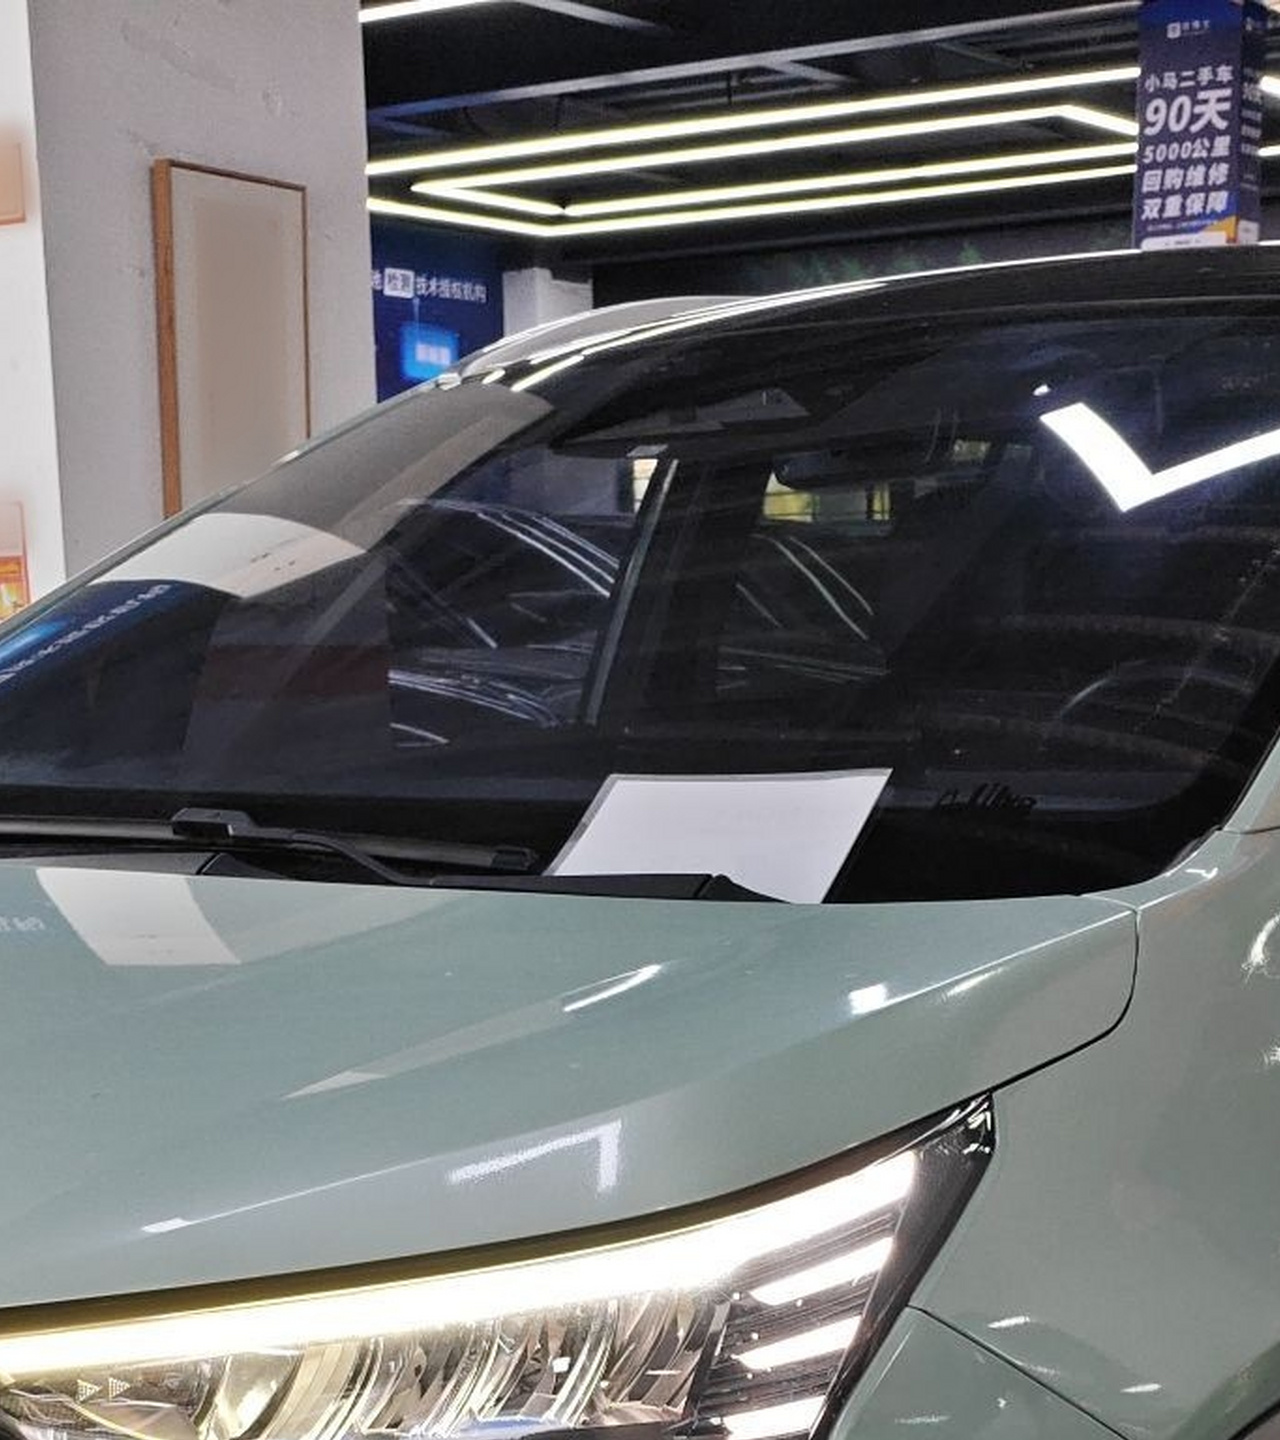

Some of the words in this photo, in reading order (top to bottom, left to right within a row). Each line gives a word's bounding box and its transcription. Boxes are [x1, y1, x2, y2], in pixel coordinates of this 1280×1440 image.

[1144, 64, 1233, 92] 小马二手车
[1143, 88, 1233, 136] 90天
[1142, 135, 1231, 163] 5000公里
[1141, 162, 1230, 193] 回购维修
[1141, 190, 1229, 221] 双重保障
